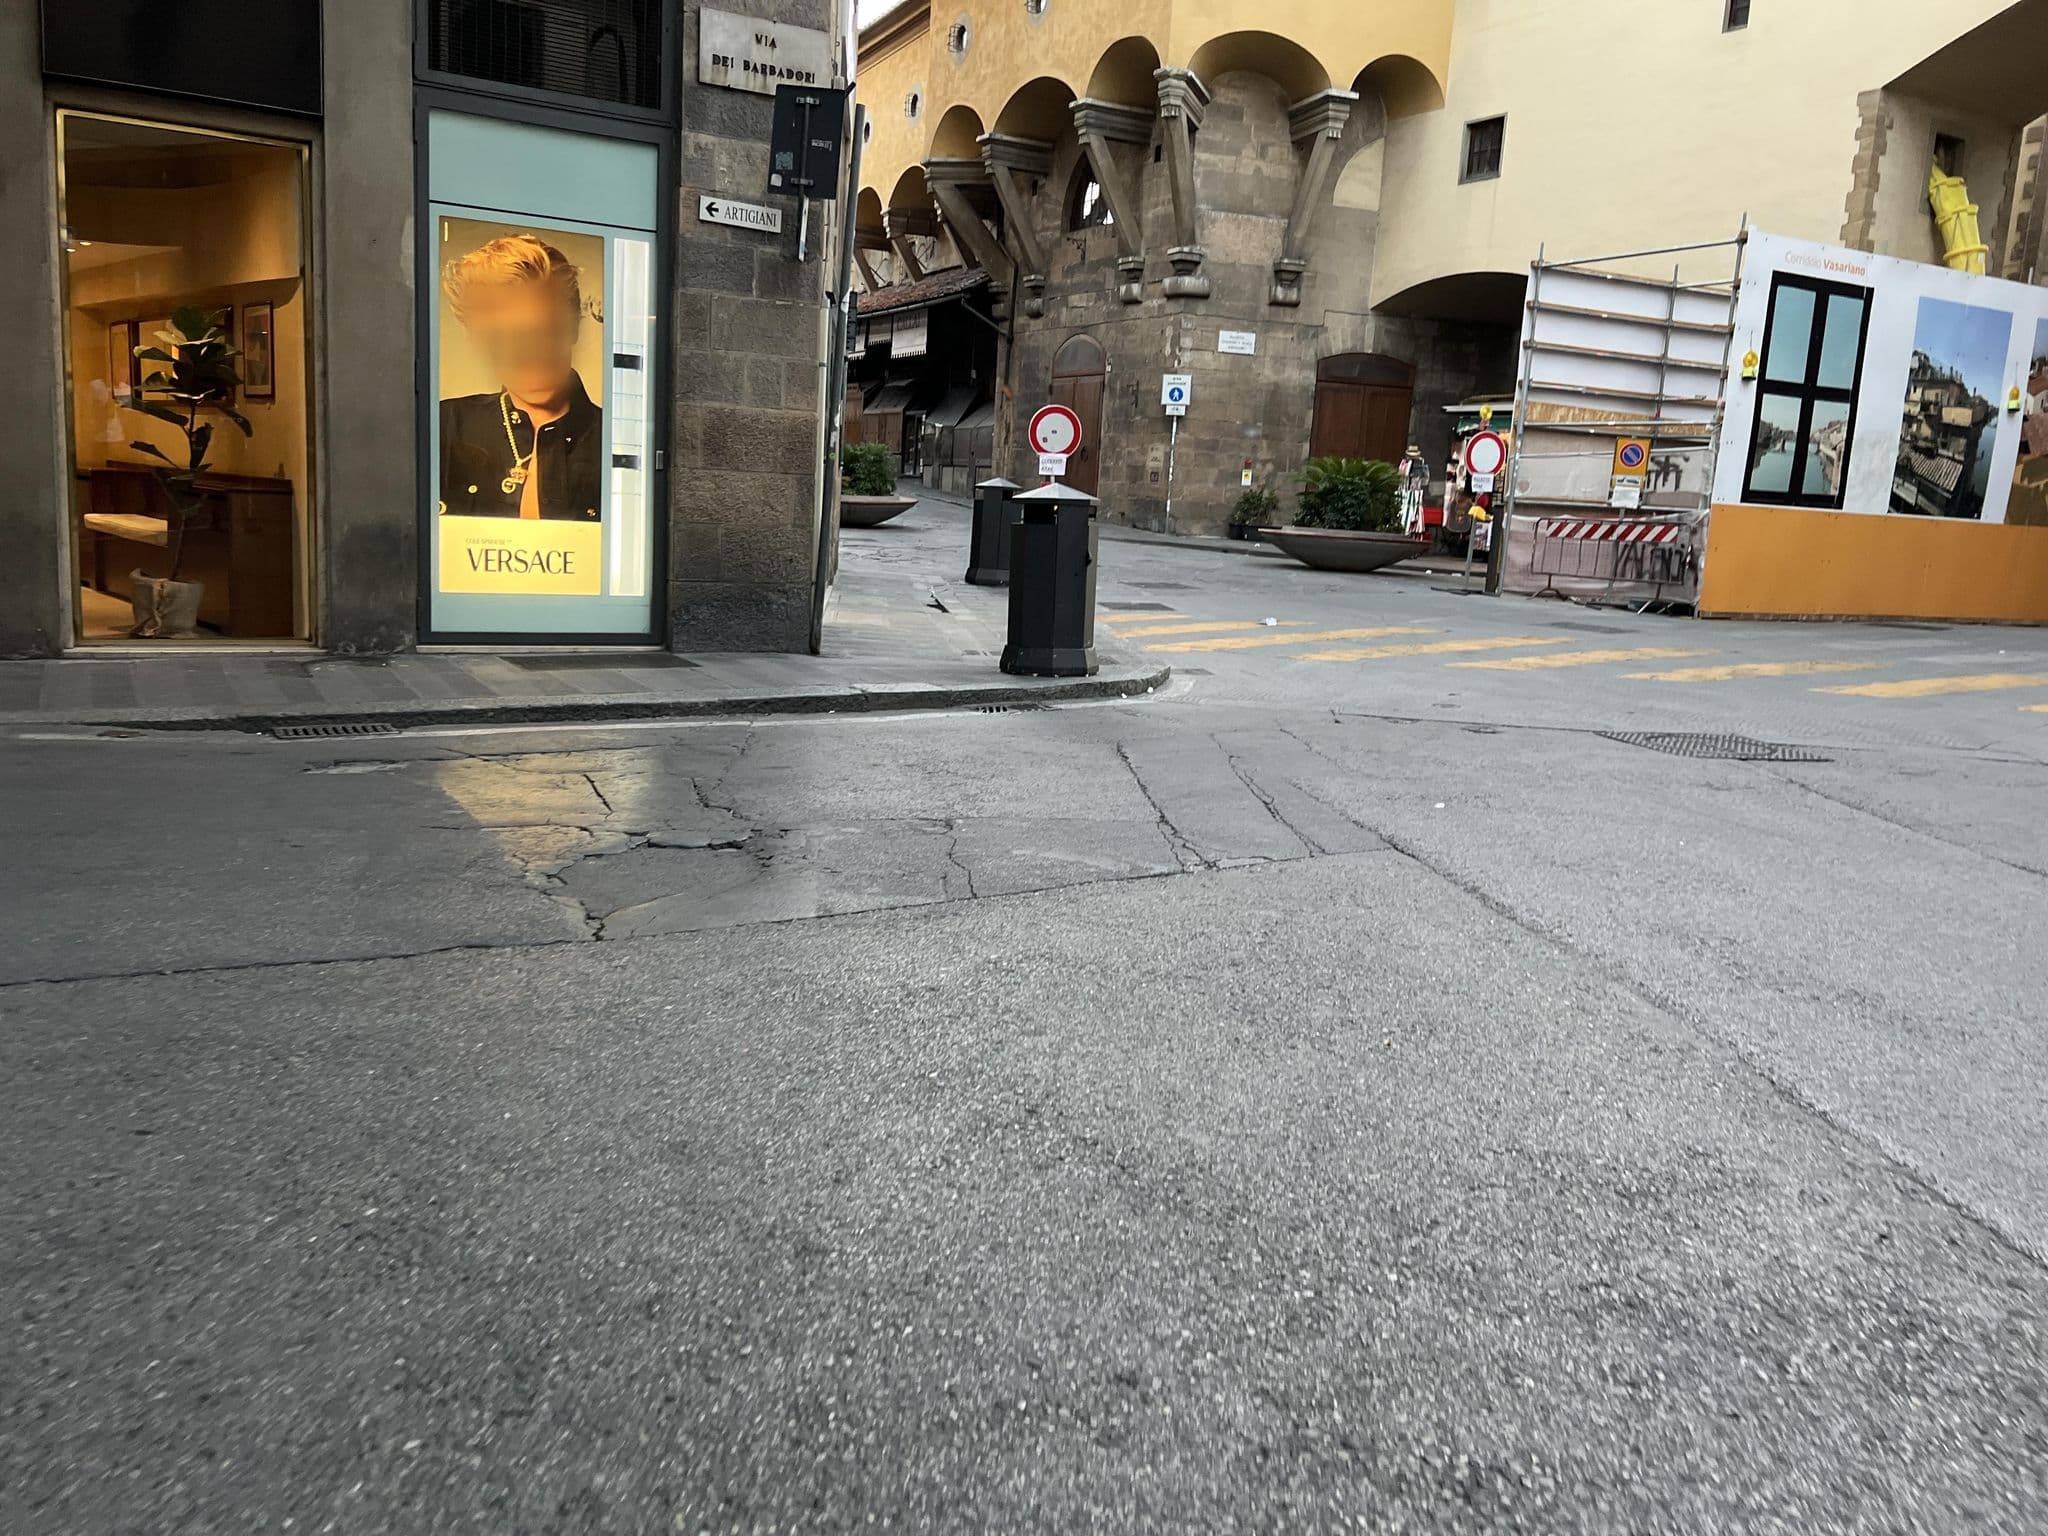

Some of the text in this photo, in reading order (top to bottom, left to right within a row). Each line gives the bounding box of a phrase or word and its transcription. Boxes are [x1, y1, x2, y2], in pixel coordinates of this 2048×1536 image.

[755, 33, 777, 49] VIA
[712, 53, 815, 84] DEI BARBADORI
[724, 206, 777, 228] ARTIGIANI
[1823, 258, 1866, 277] Vasariano
[467, 547, 576, 575] VERSACE
